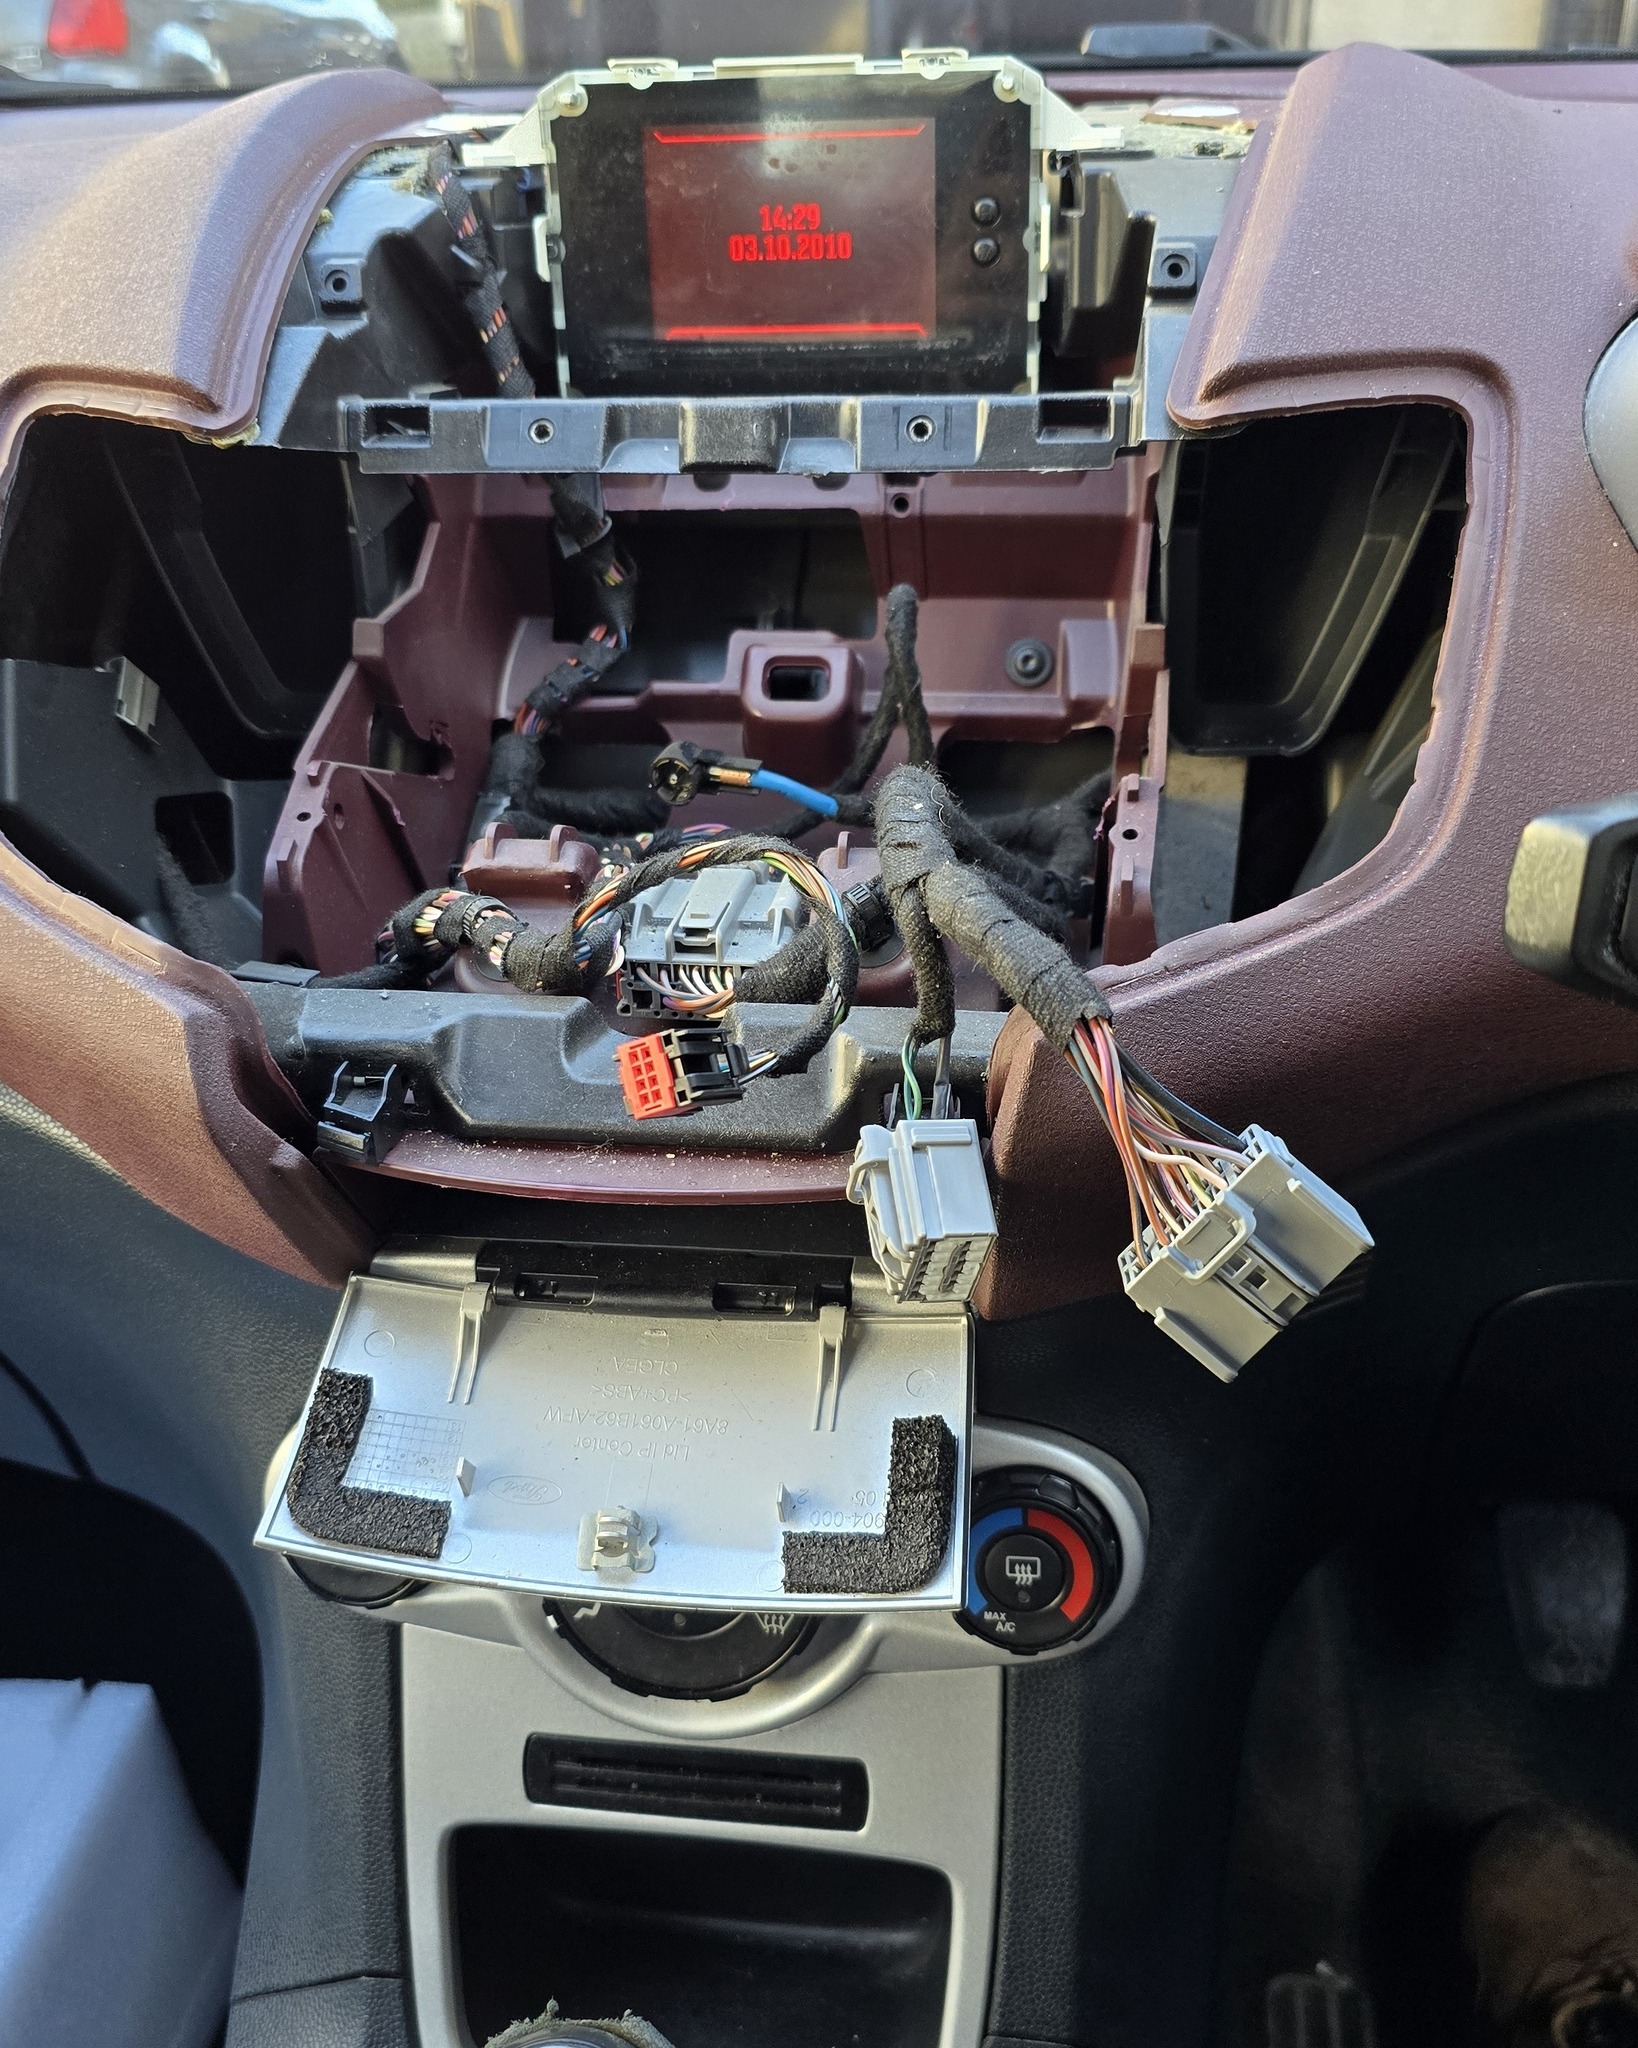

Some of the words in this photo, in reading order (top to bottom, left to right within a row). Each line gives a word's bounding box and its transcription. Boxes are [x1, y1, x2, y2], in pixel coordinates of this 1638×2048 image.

[759, 203, 821, 231] 14:29
[728, 232, 852, 262] 03.10.2010
[574, 1436, 633, 1457] Center
[662, 1443, 690, 1462] Lid
[500, 1478, 550, 1502] Ford
[984, 1611, 1007, 1622] MAX
[995, 1621, 1016, 1632] A/C
